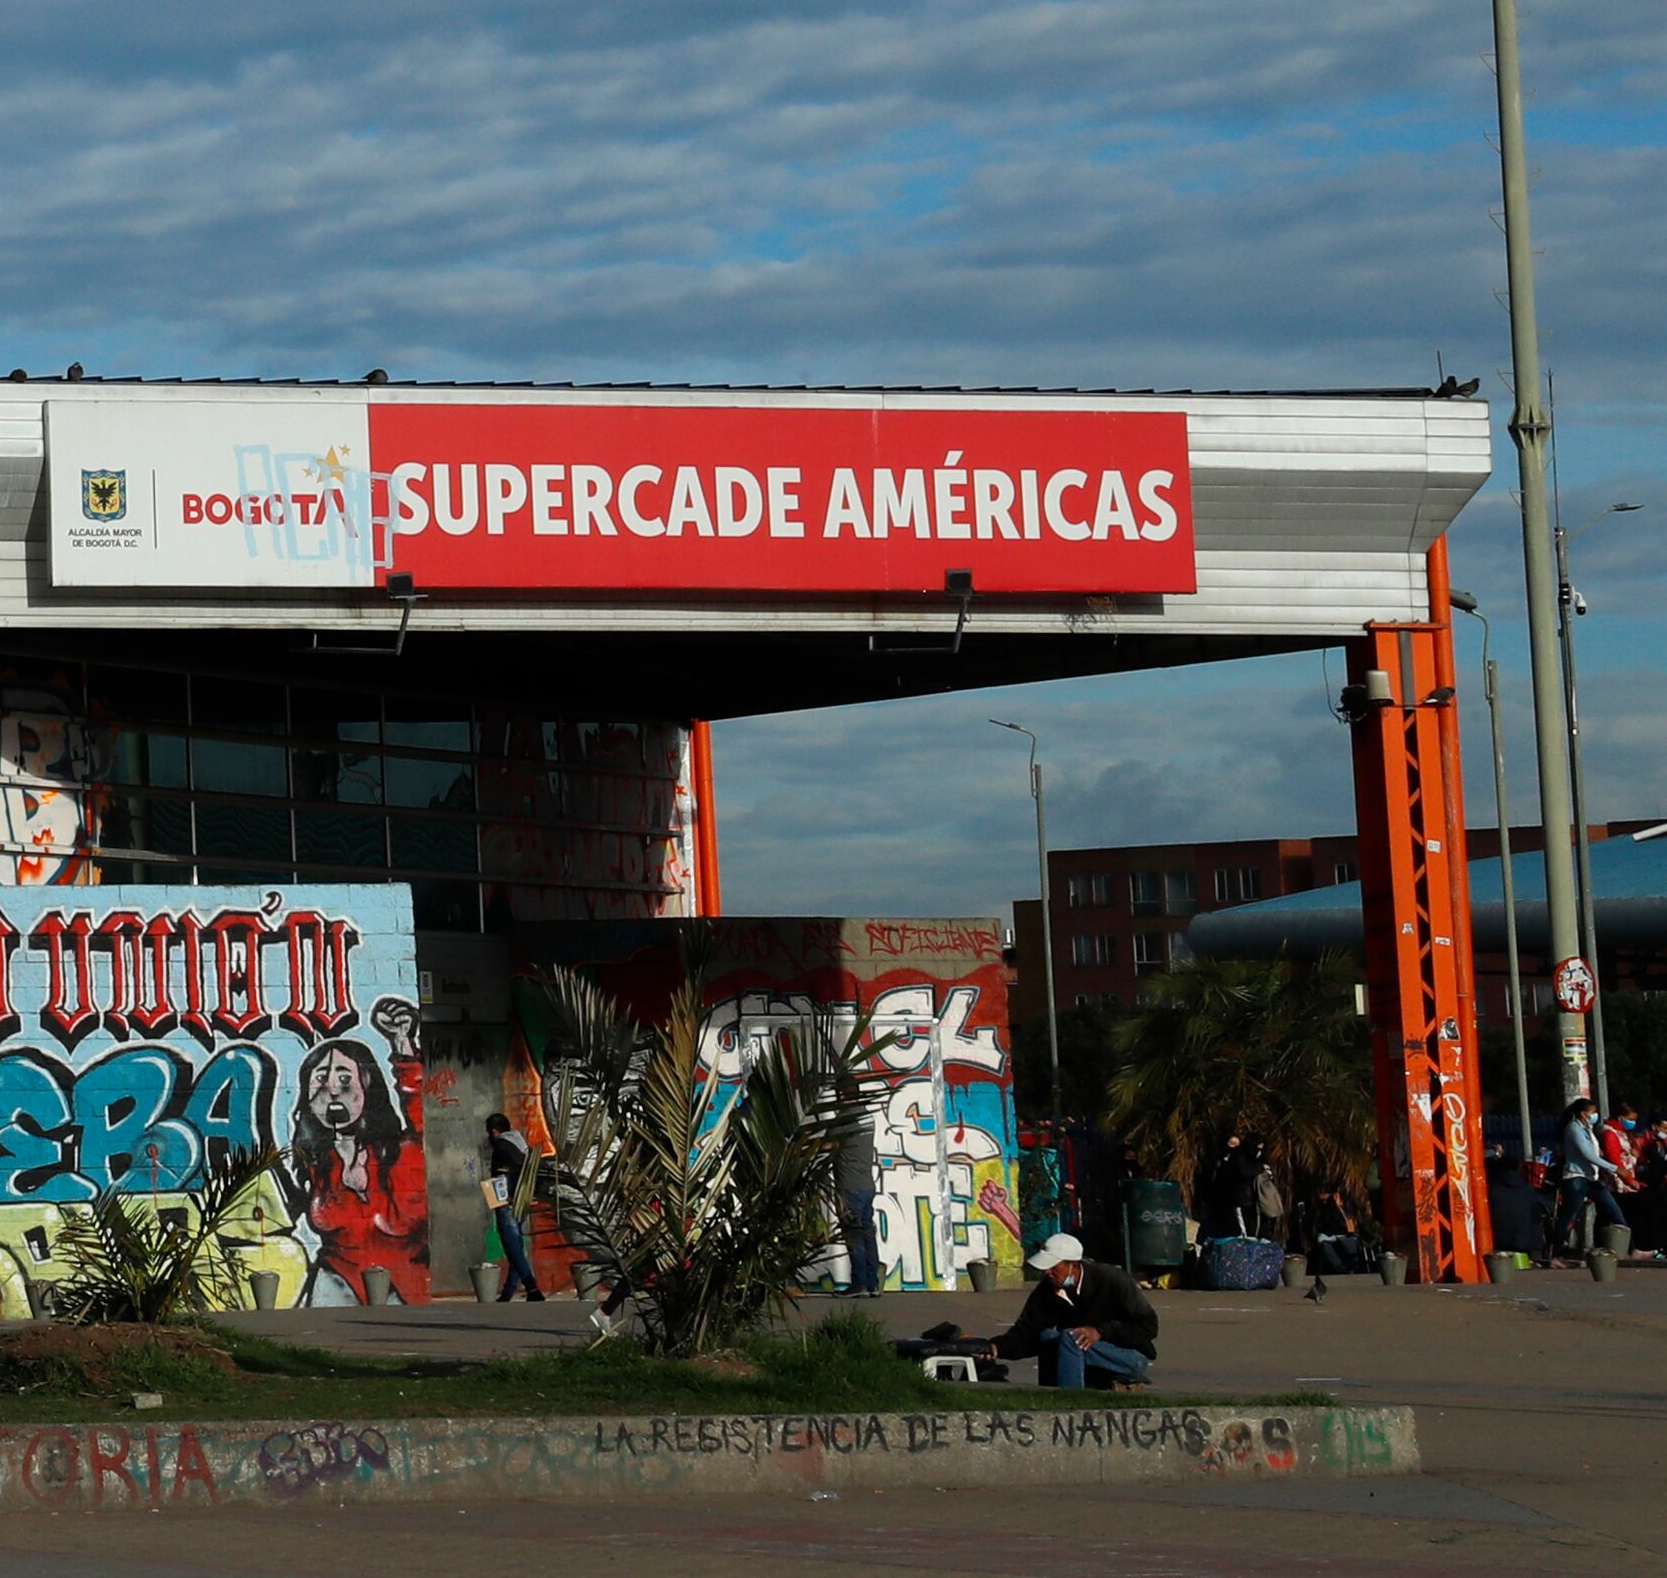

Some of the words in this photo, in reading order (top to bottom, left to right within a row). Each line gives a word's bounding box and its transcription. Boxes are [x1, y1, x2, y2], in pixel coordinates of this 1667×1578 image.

[393, 462, 805, 540] SUPERCADE
[822, 449, 1178, 543] AMÉRICAS
[67, 527, 110, 538] ALCALDÍA
[113, 529, 143, 538] MAYOR
[72, 540, 84, 548] DE
[85, 538, 122, 548] BOGOTÁ
[595, 1419, 638, 1457] LA
[906, 1413, 951, 1454] DE
[964, 1410, 1036, 1449] LAS
